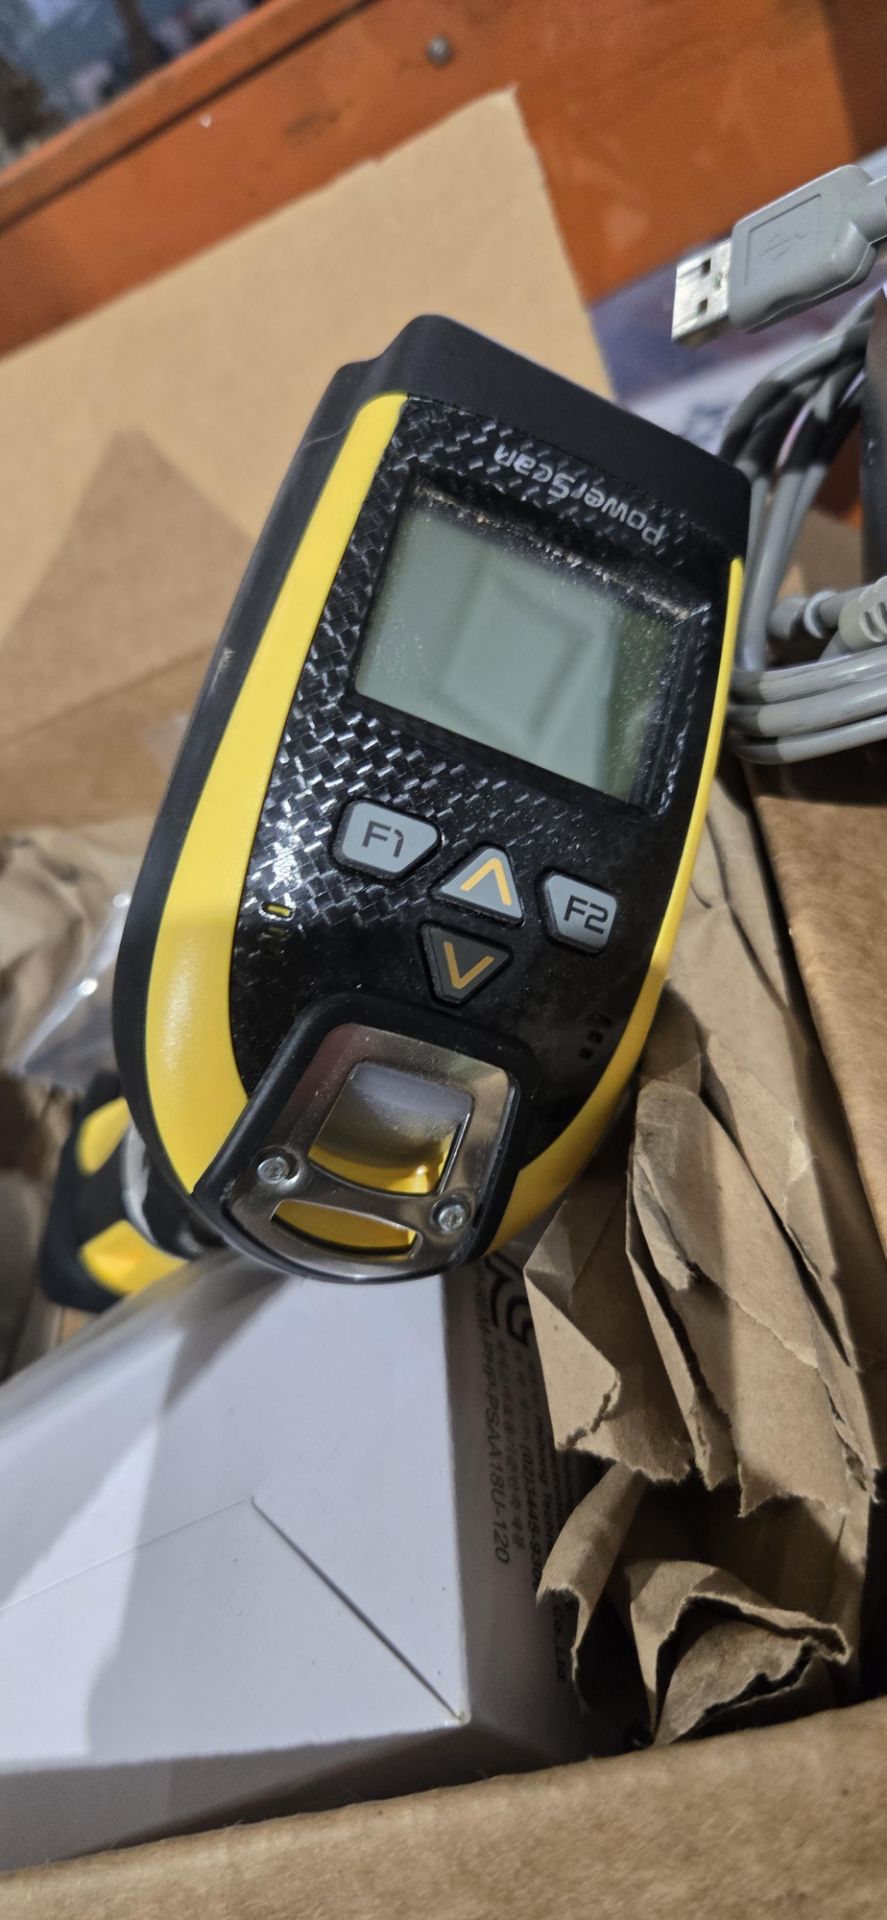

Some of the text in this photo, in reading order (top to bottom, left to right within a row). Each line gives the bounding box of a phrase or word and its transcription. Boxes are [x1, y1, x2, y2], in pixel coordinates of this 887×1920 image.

[494, 444, 666, 546] PowerScan
[362, 820, 404, 858] F1
[563, 895, 608, 935] F2
